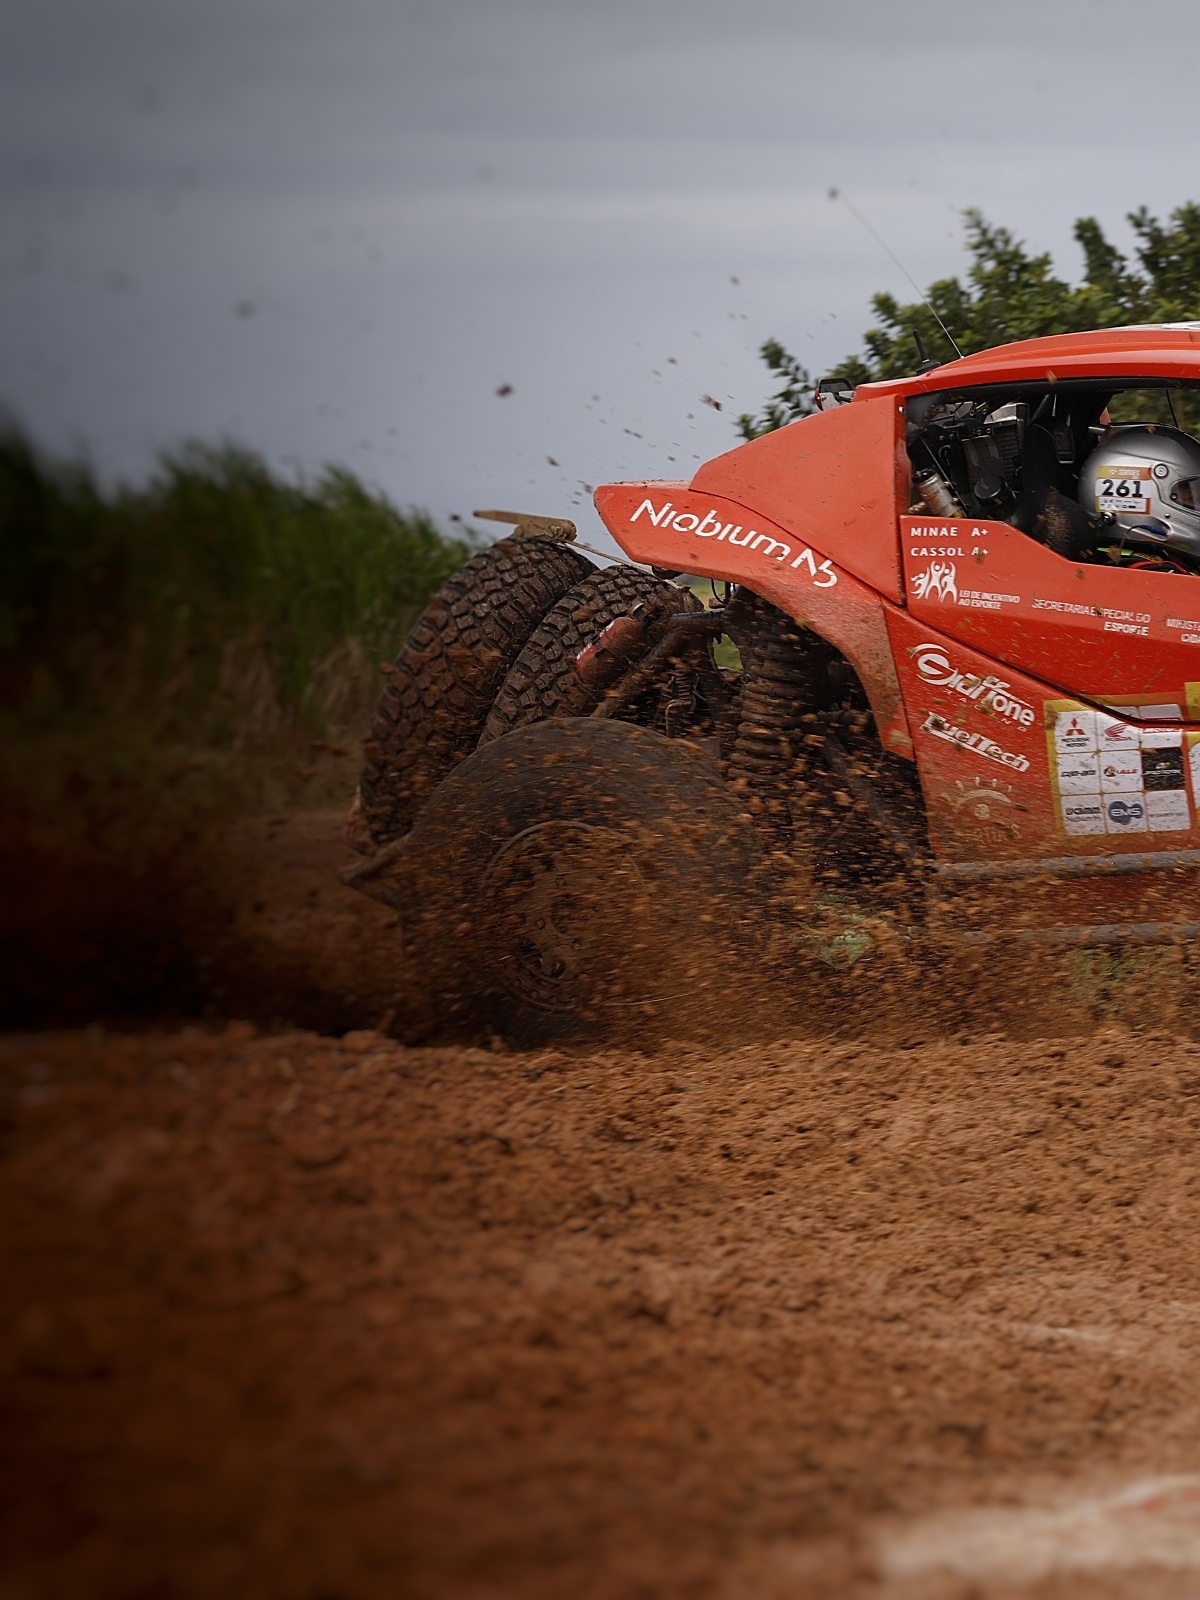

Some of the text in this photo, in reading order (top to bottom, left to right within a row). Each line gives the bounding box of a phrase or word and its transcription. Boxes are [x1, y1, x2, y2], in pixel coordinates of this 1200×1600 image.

[1102, 479, 1143, 498] 261
[630, 499, 791, 561] Niobium
[911, 527, 989, 537] MINAE A+
[910, 546, 989, 557] CASSOL A+
[1032, 598, 1090, 616] SECRETARIA
[1104, 621, 1150, 636] ESPORTE
[920, 711, 1031, 773] FuelTech
